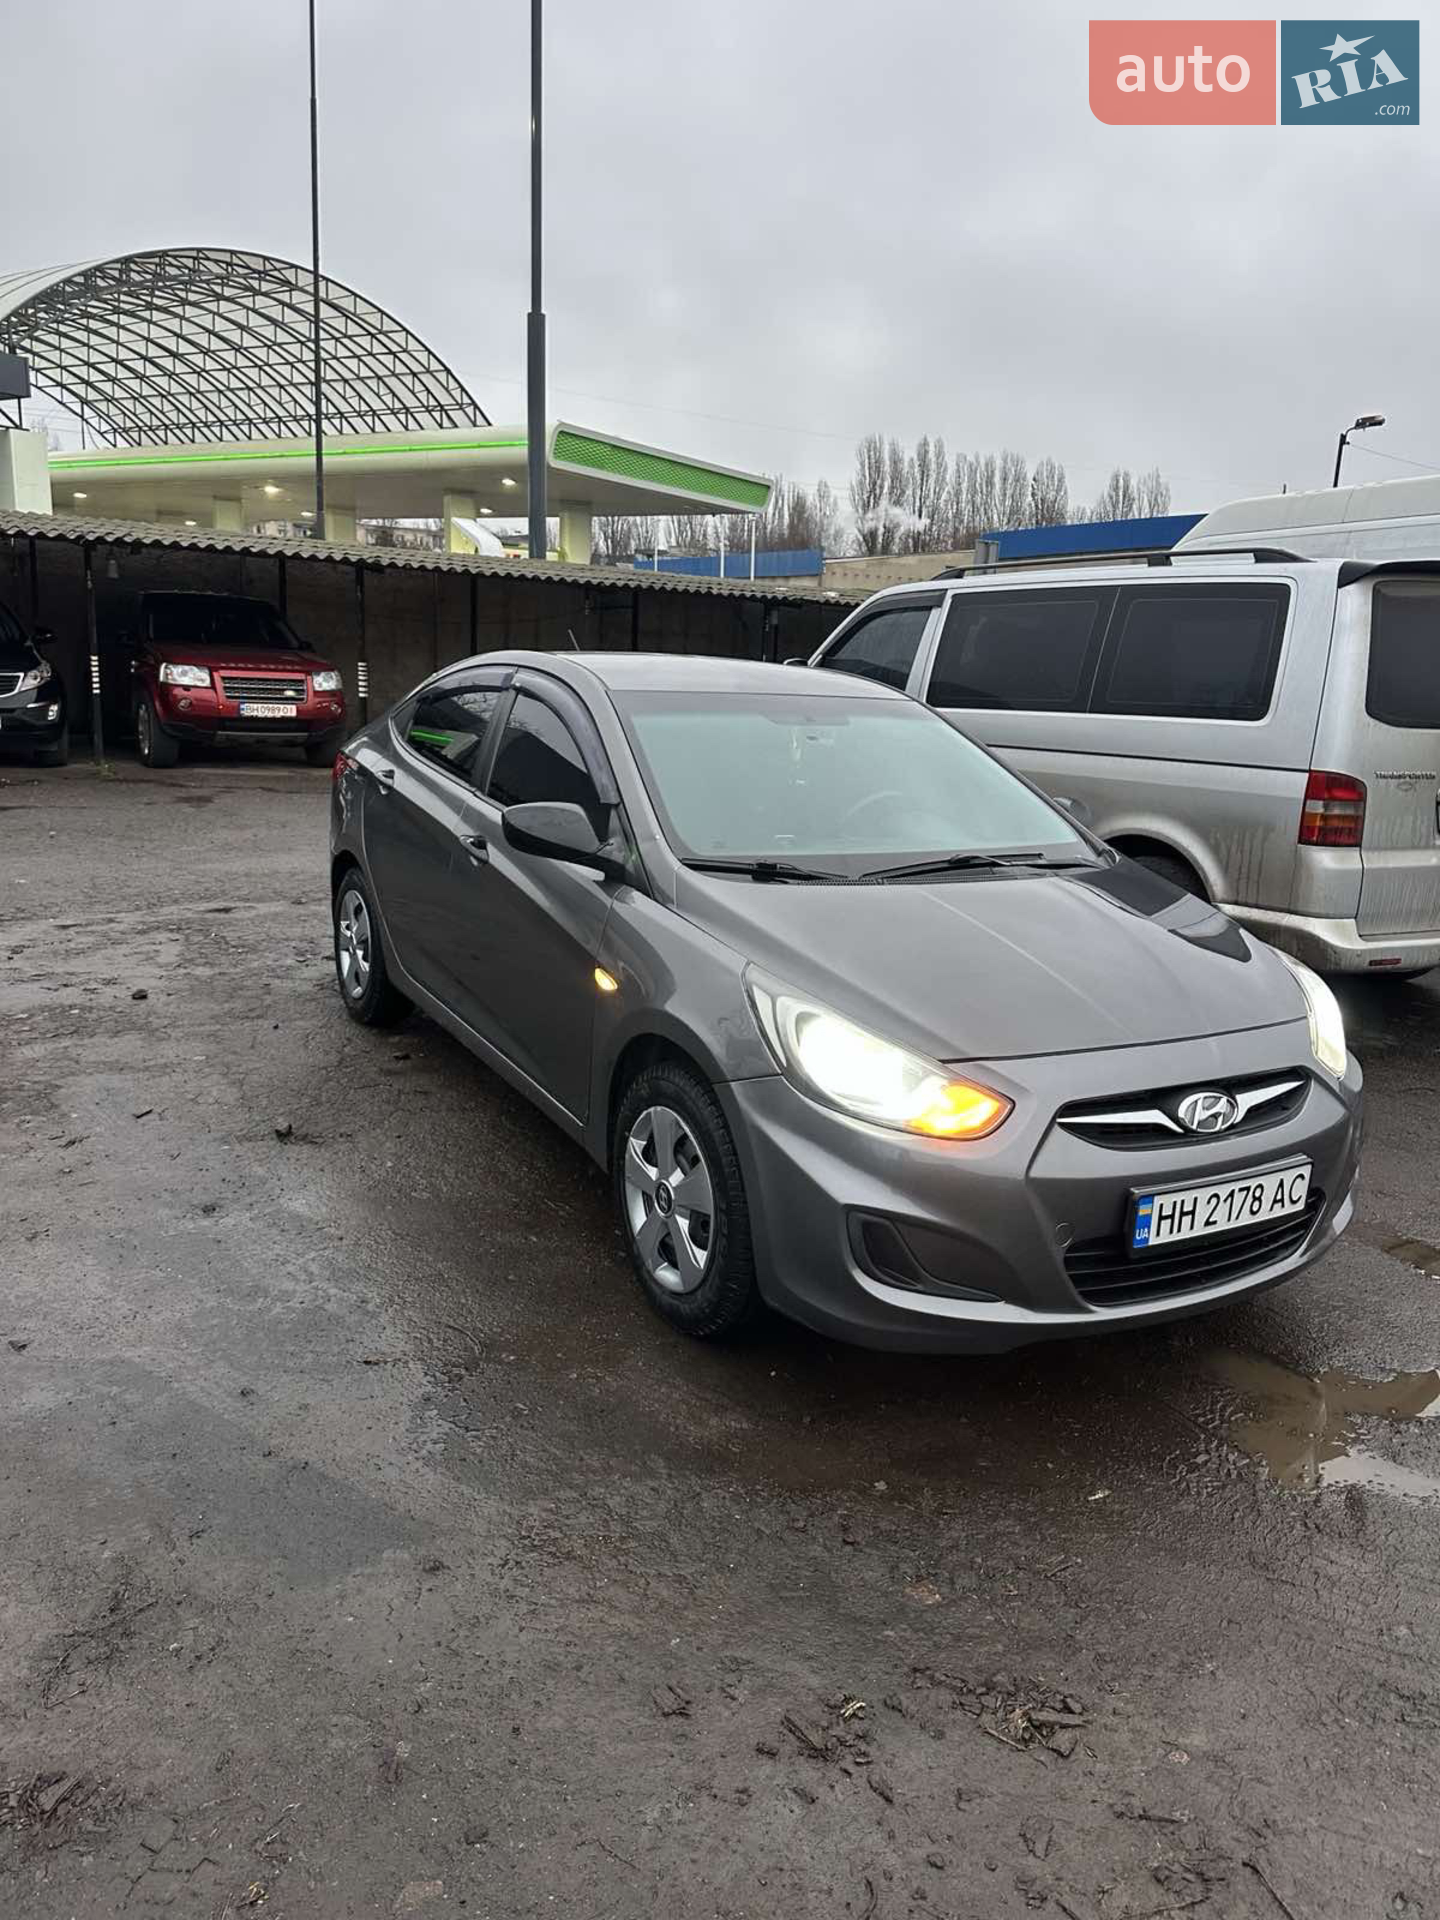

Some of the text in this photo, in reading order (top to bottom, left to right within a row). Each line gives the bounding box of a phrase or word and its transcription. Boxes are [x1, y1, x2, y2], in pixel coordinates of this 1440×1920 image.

[1155, 1173, 1306, 1238] HH 2178 AC
[1135, 1229, 1149, 1240] UA
